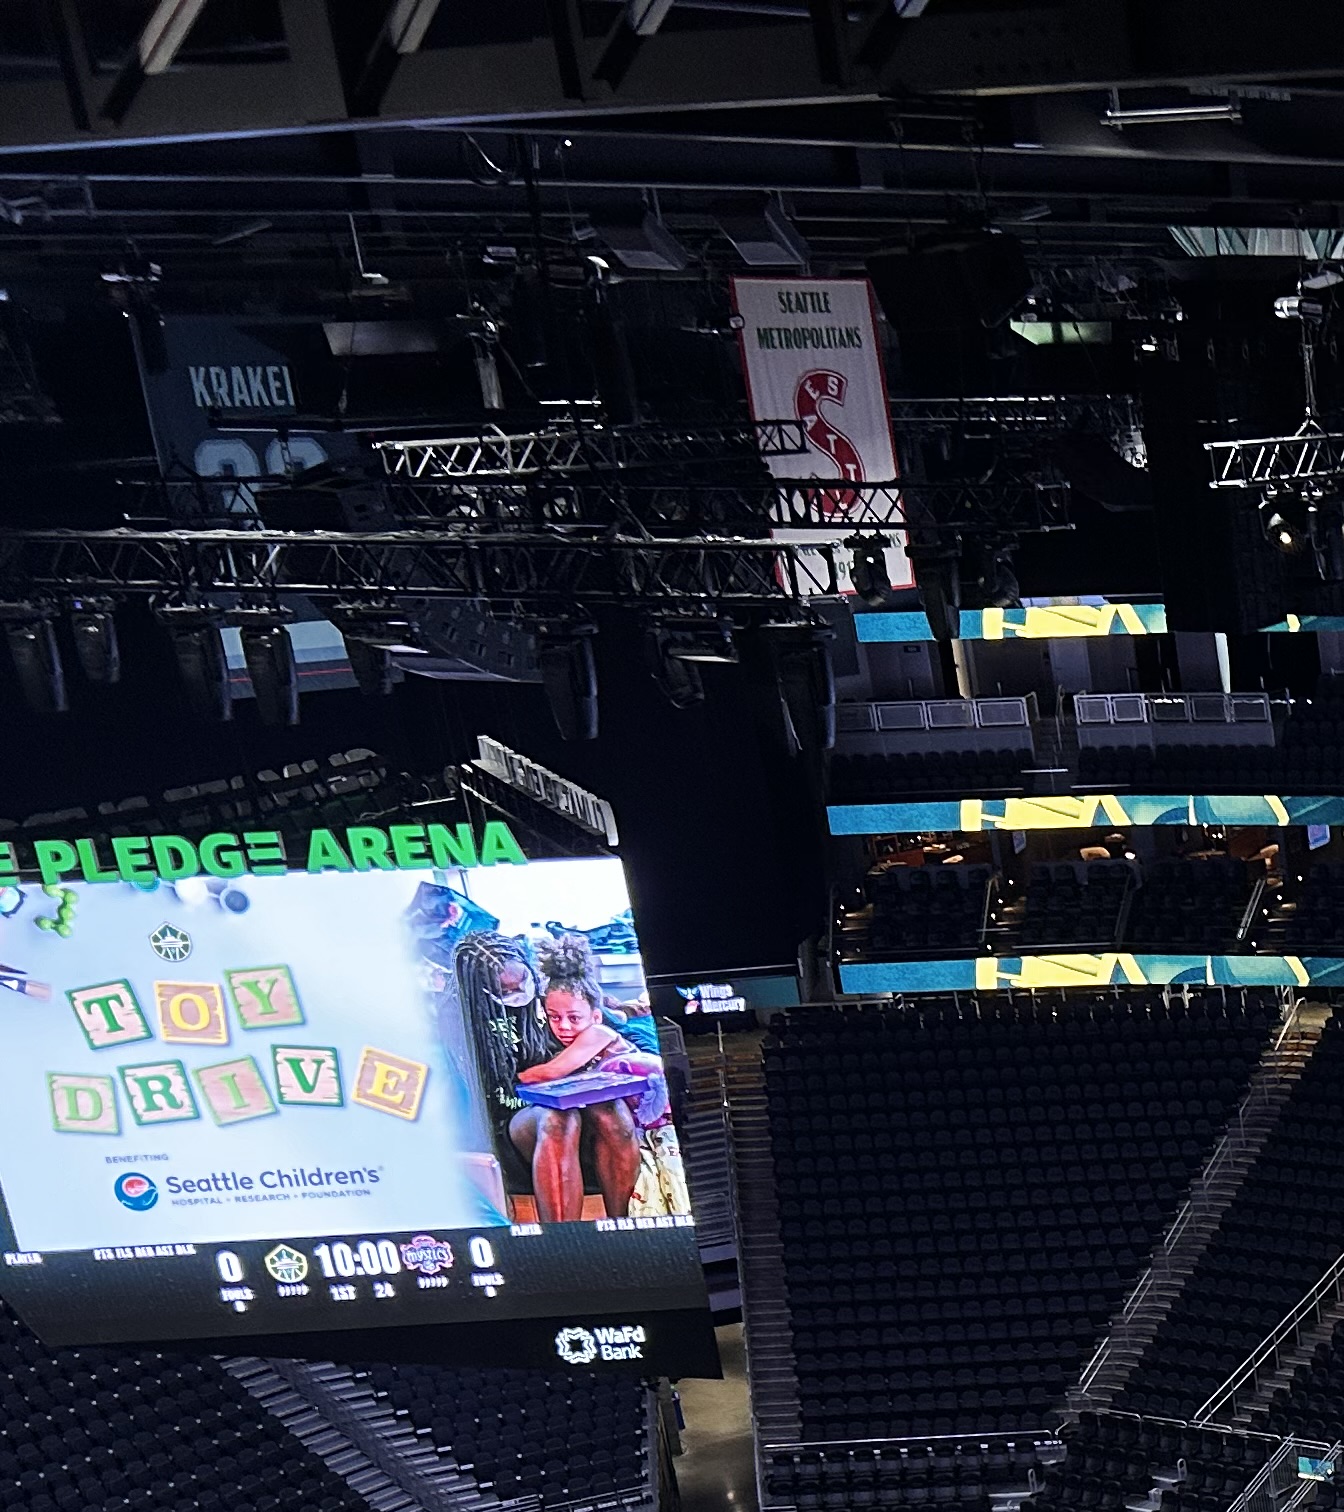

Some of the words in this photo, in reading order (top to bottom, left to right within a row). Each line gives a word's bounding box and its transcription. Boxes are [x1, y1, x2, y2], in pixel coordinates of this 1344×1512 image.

[778, 291, 831, 313] SEATTLE
[756, 327, 862, 350] METROPOLITANS
[34, 831, 287, 884] PLEDGE
[306, 821, 528, 873] ARENA
[83, 977, 281, 1034] TOY
[65, 1056, 407, 1122] DRIVE
[165, 1171, 253, 1194] Seattle
[259, 1166, 380, 1189] Children's
[216, 1249, 244, 1283] 0
[313, 1239, 401, 1279] 10:00
[468, 1236, 495, 1268] 0
[594, 1326, 646, 1345] WaFd
[600, 1343, 643, 1361] Bank
